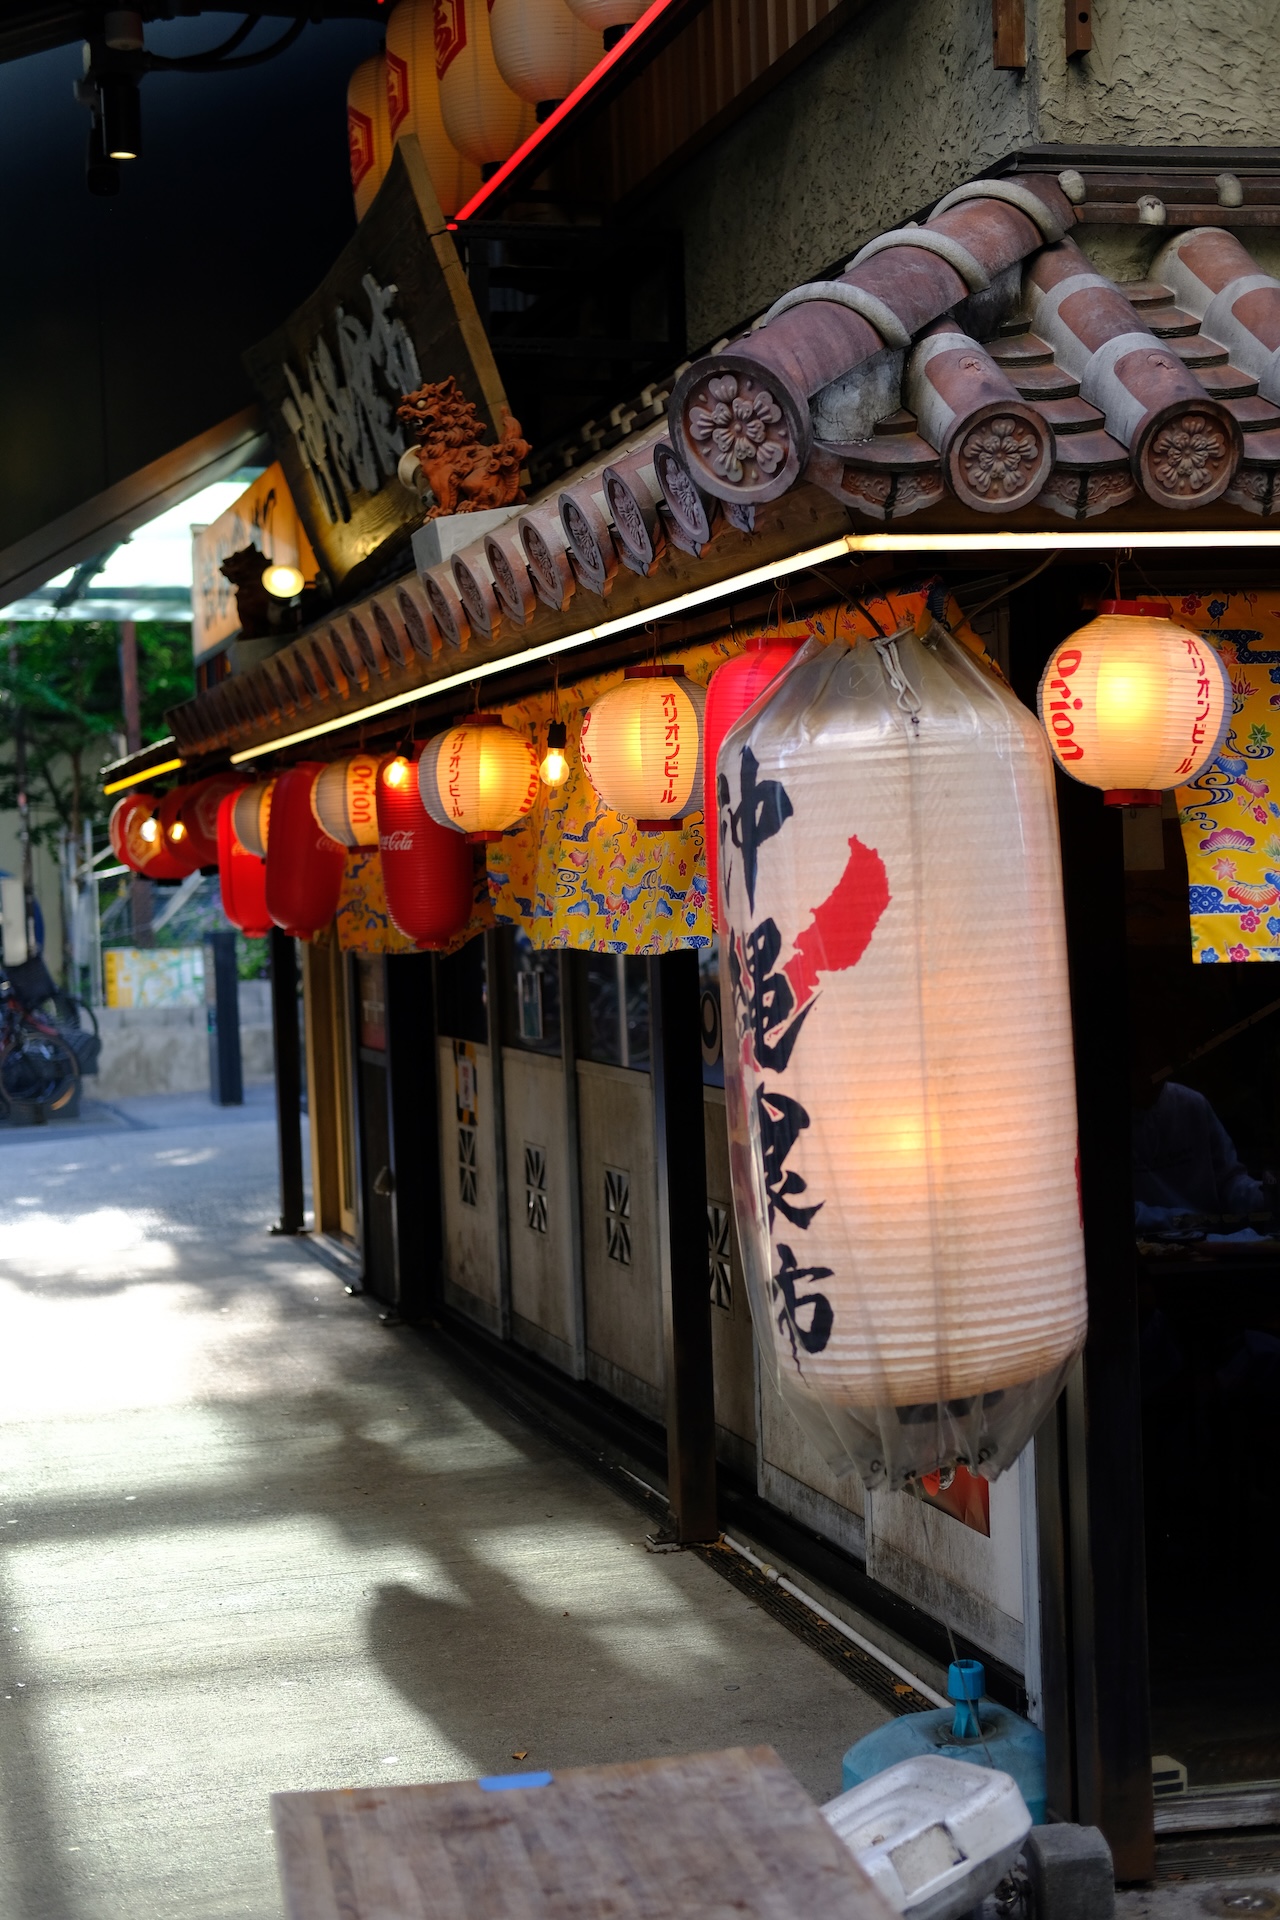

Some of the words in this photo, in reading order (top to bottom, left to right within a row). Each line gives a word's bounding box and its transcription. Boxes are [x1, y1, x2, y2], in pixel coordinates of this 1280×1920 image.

[660, 692, 680, 804] オリオンビール
[1050, 649, 1084, 761] Orion
[1174, 638, 1211, 775] オリオンビール
[448, 731, 468, 818] オリオンビール
